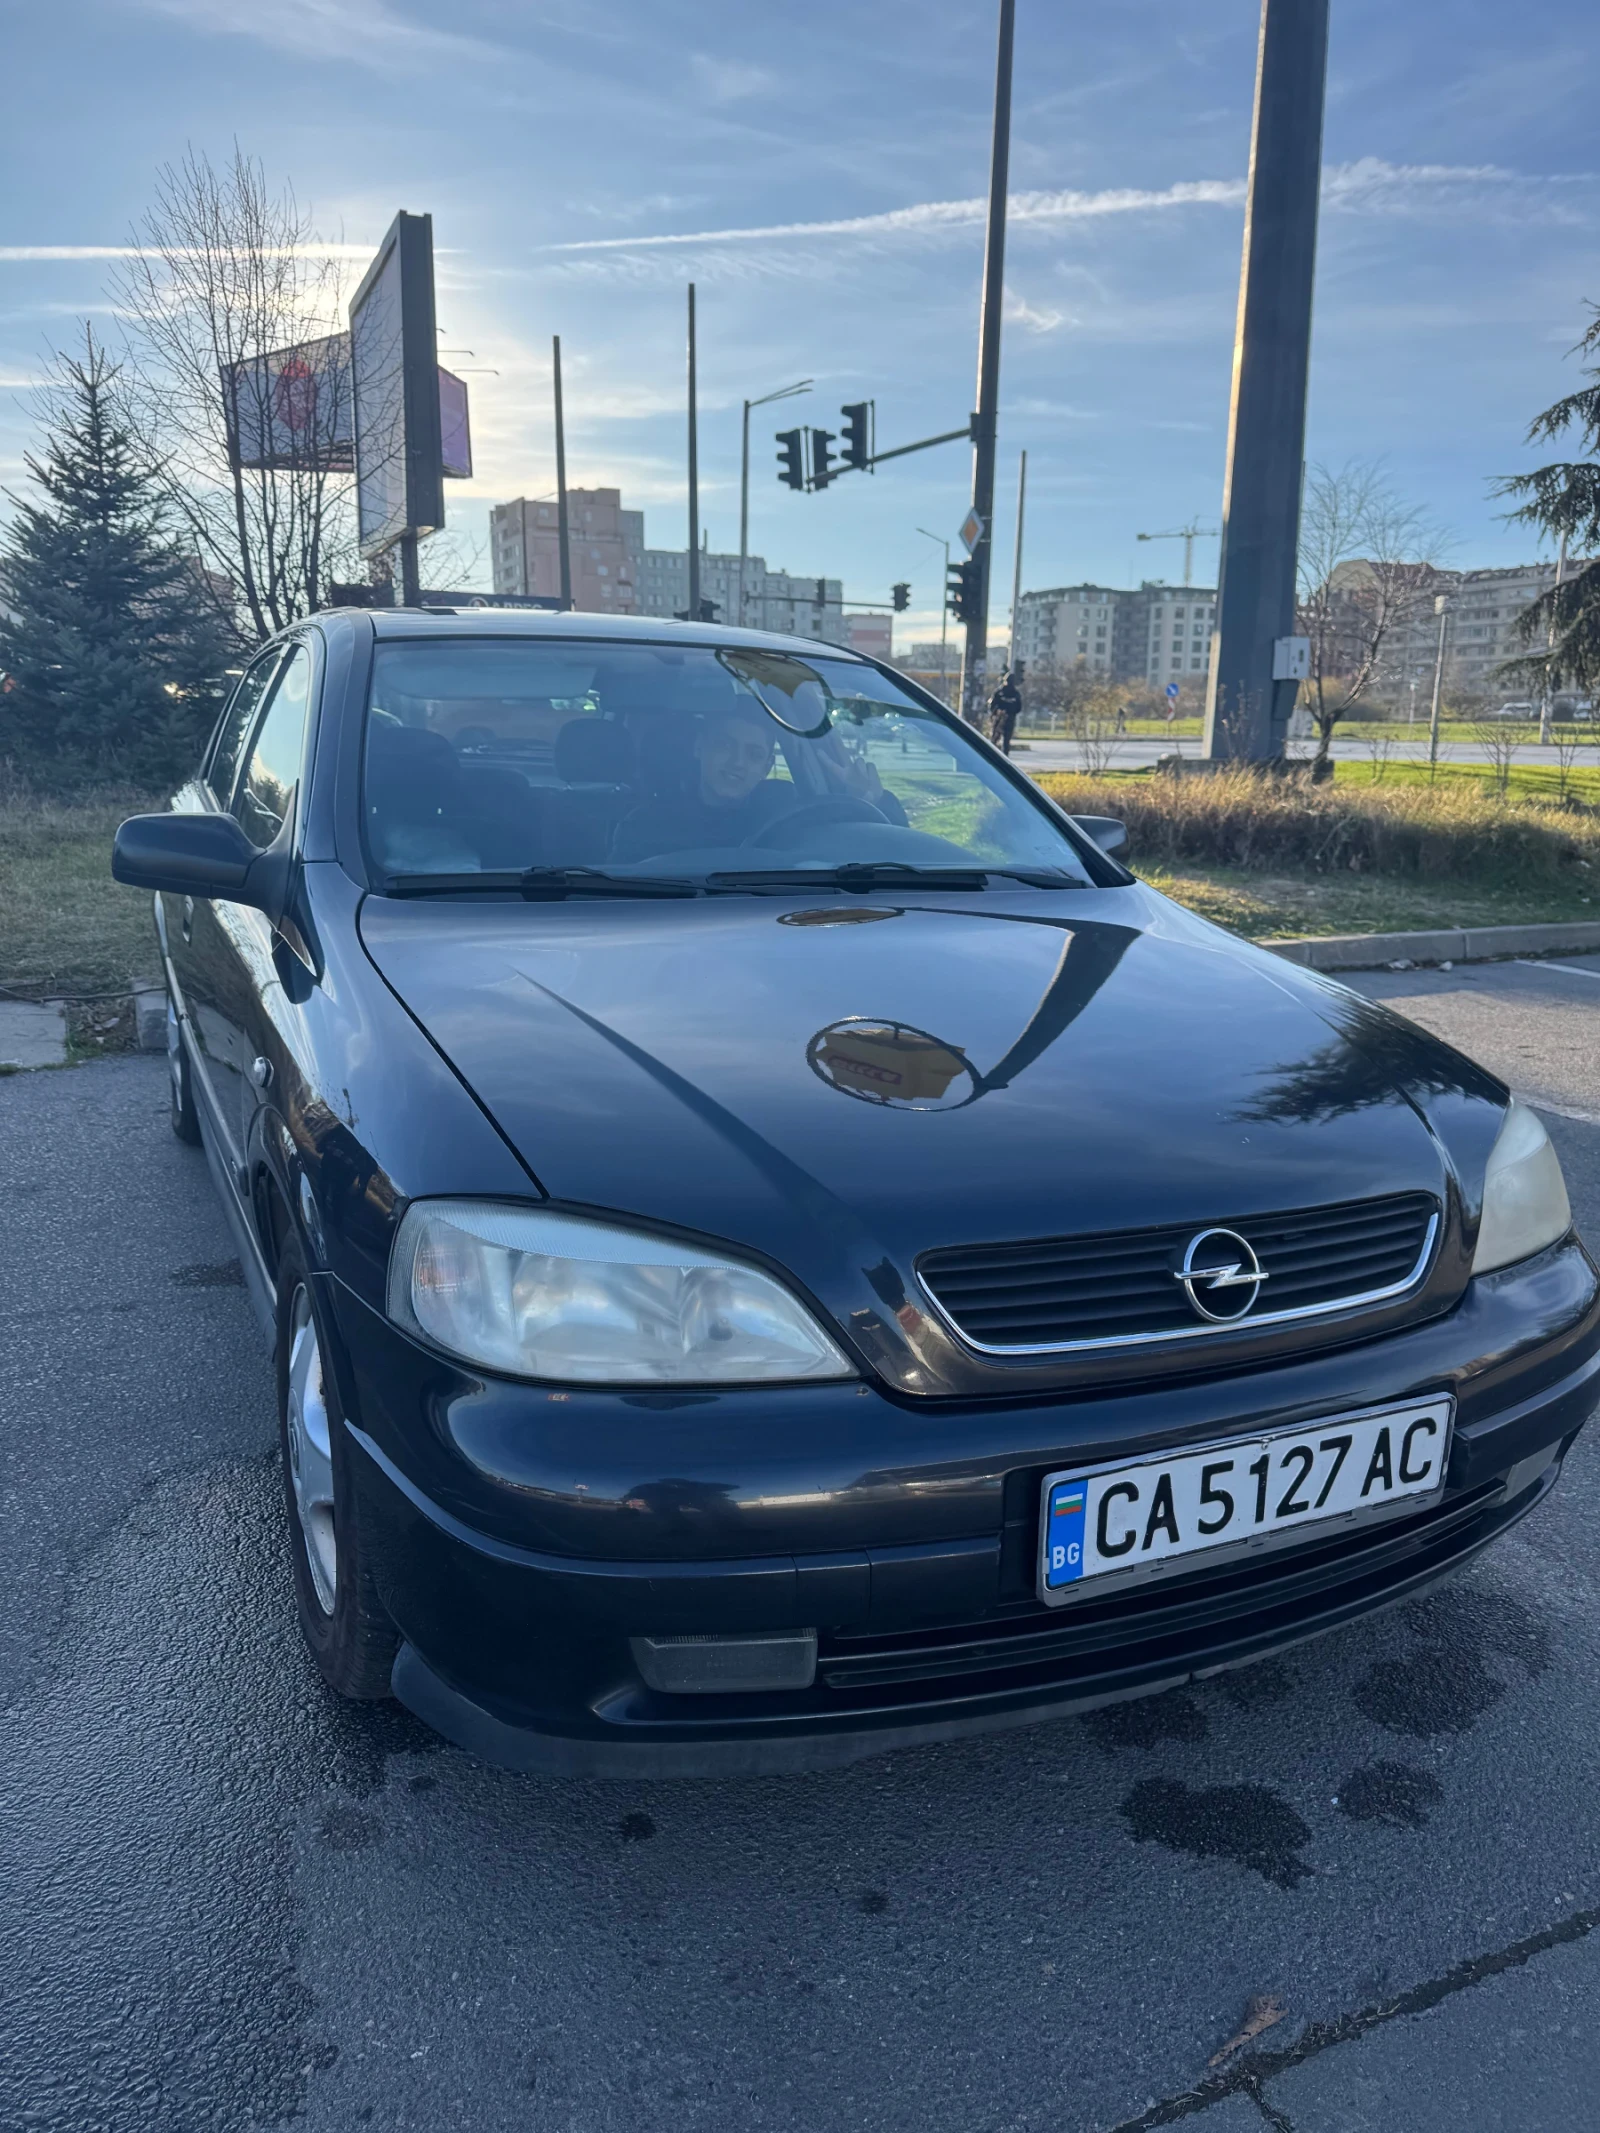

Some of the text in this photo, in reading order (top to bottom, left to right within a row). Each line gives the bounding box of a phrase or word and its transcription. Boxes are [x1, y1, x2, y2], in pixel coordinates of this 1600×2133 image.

[1096, 1417, 1437, 1558] CA 5127 AC
[1053, 1542, 1080, 1570] BG
